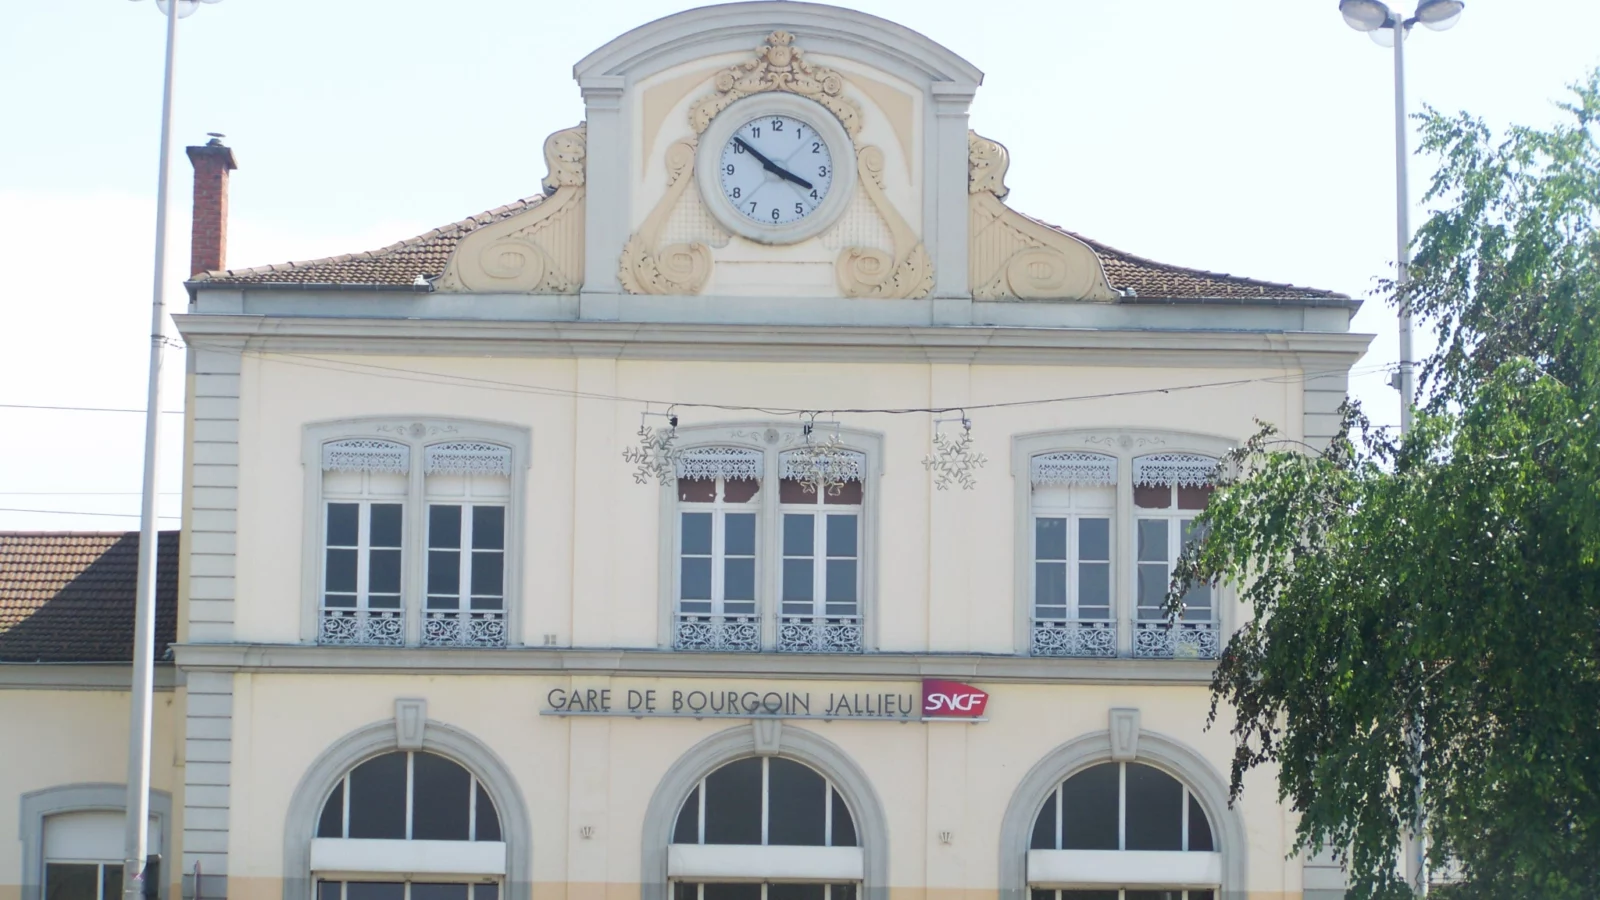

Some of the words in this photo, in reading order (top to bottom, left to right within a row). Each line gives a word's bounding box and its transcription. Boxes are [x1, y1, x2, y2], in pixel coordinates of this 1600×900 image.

[771, 120, 783, 131] 12
[752, 128, 760, 138] 11
[796, 128, 801, 139] 1
[732, 144, 745, 154] 10
[812, 142, 820, 153] 2
[726, 164, 734, 175] 9
[818, 166, 826, 177] 3
[732, 187, 741, 198] 8
[810, 189, 818, 200] 4
[750, 202, 757, 213] 7
[795, 203, 803, 214] 5
[772, 208, 780, 220] 6
[548, 688, 611, 711] GARE
[628, 690, 656, 712] DE
[672, 690, 810, 714] BOURGOIN
[826, 693, 913, 716] JALLIEU
[925, 693, 985, 711] SNCF
